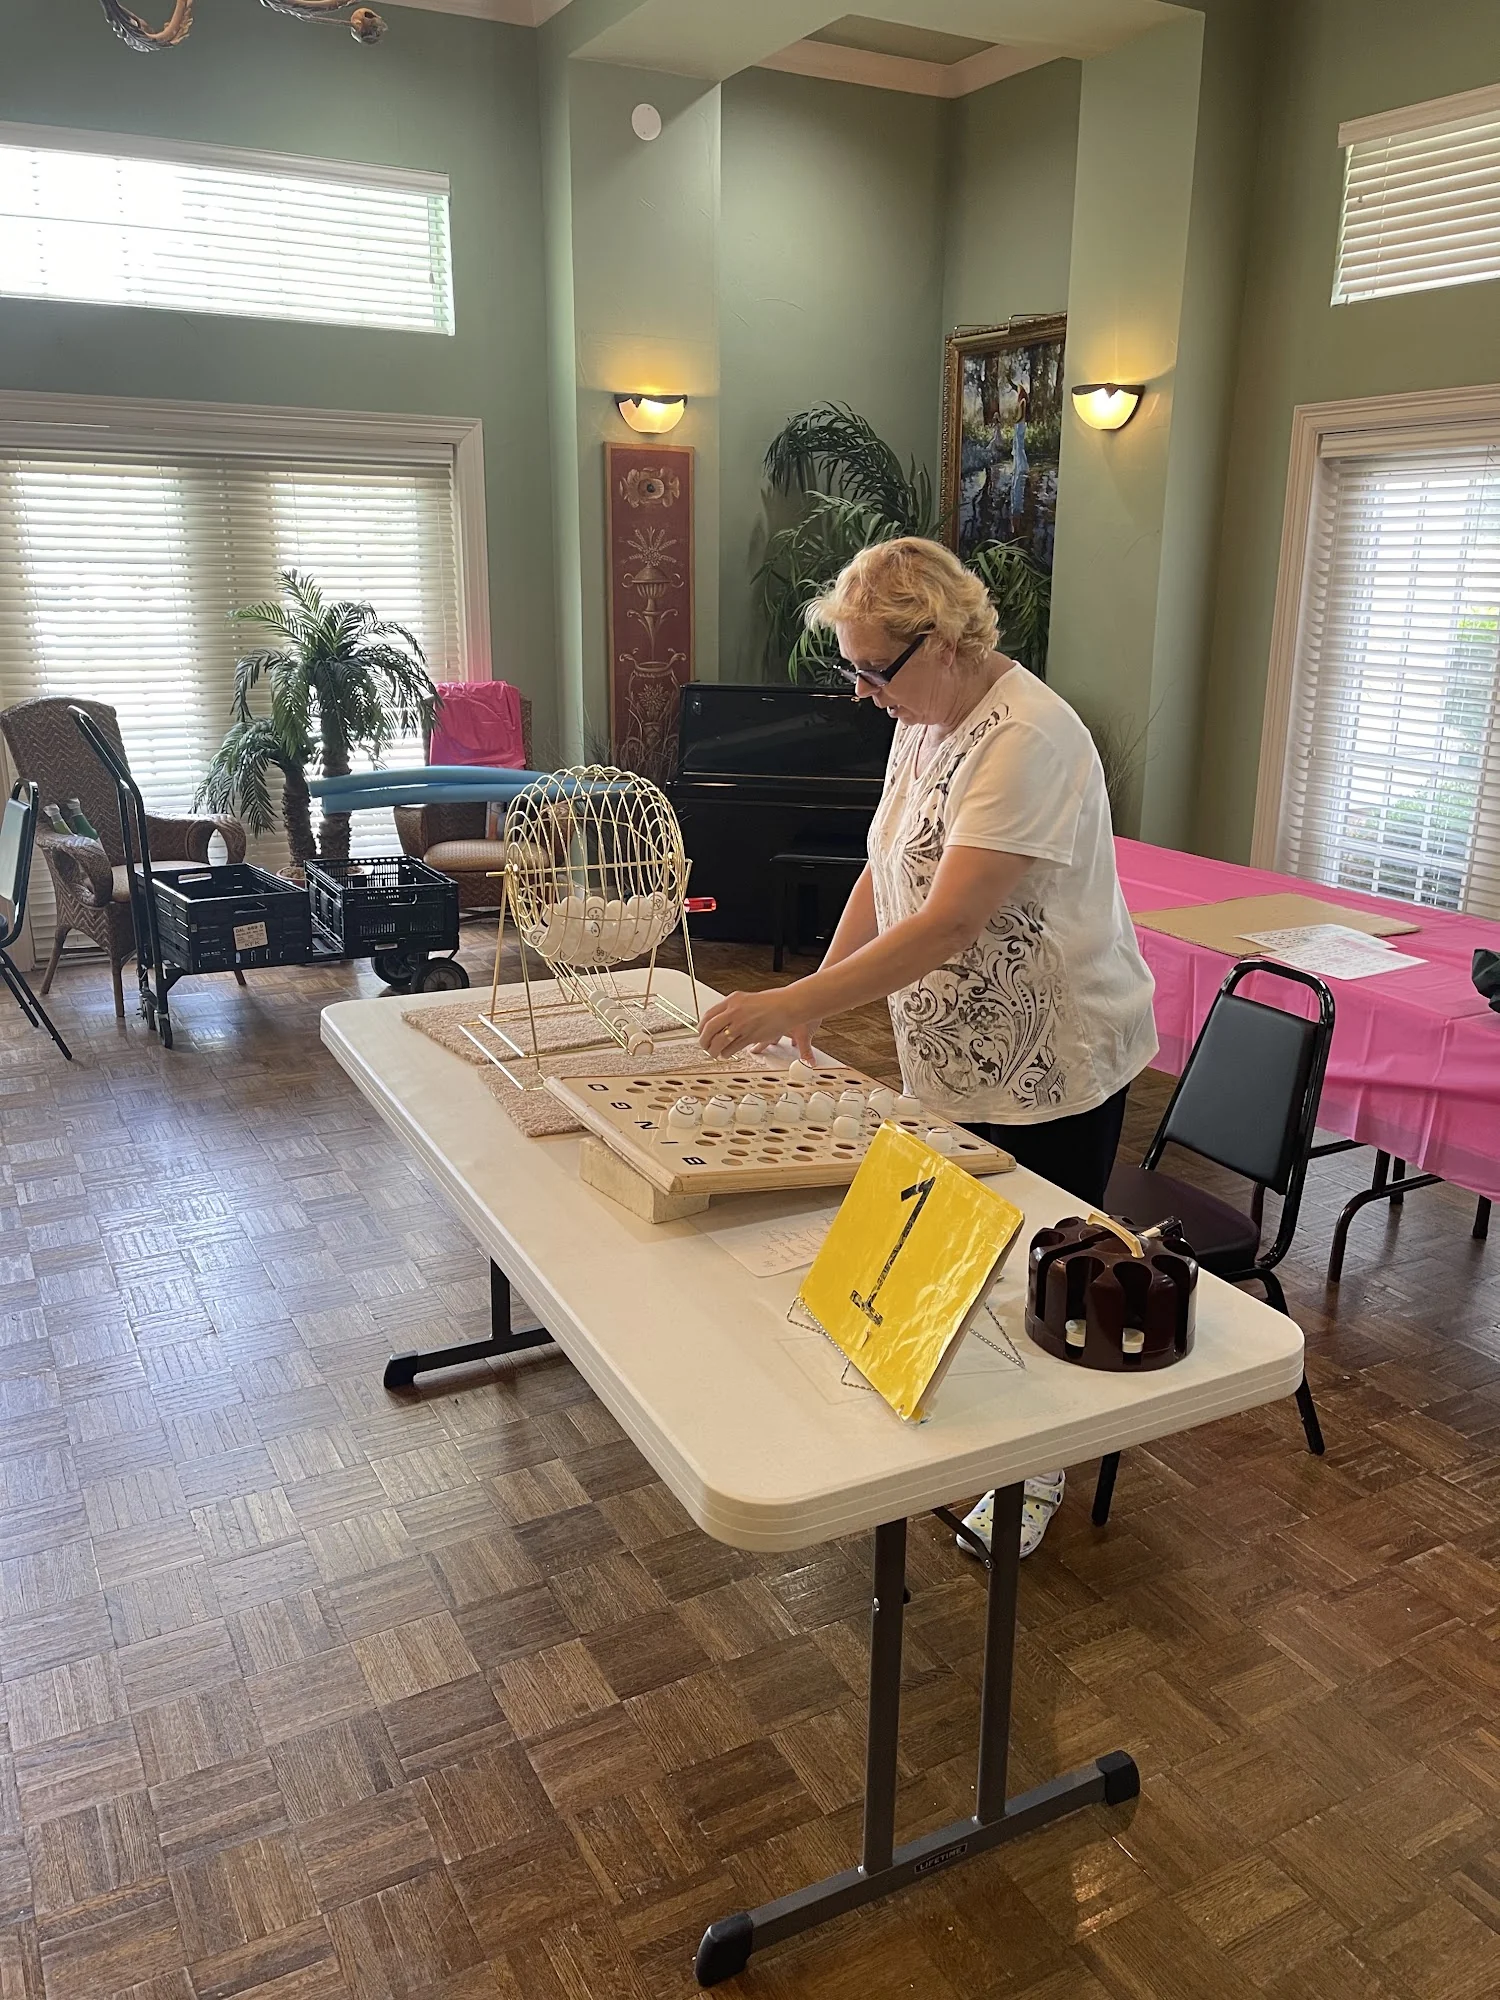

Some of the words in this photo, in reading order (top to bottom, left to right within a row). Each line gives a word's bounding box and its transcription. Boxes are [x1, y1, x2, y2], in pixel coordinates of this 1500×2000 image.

[634, 1121, 660, 1130] N
[681, 1156, 707, 1165] B
[849, 1176, 936, 1328] 1
[920, 1847, 962, 1870] LIFETIME
